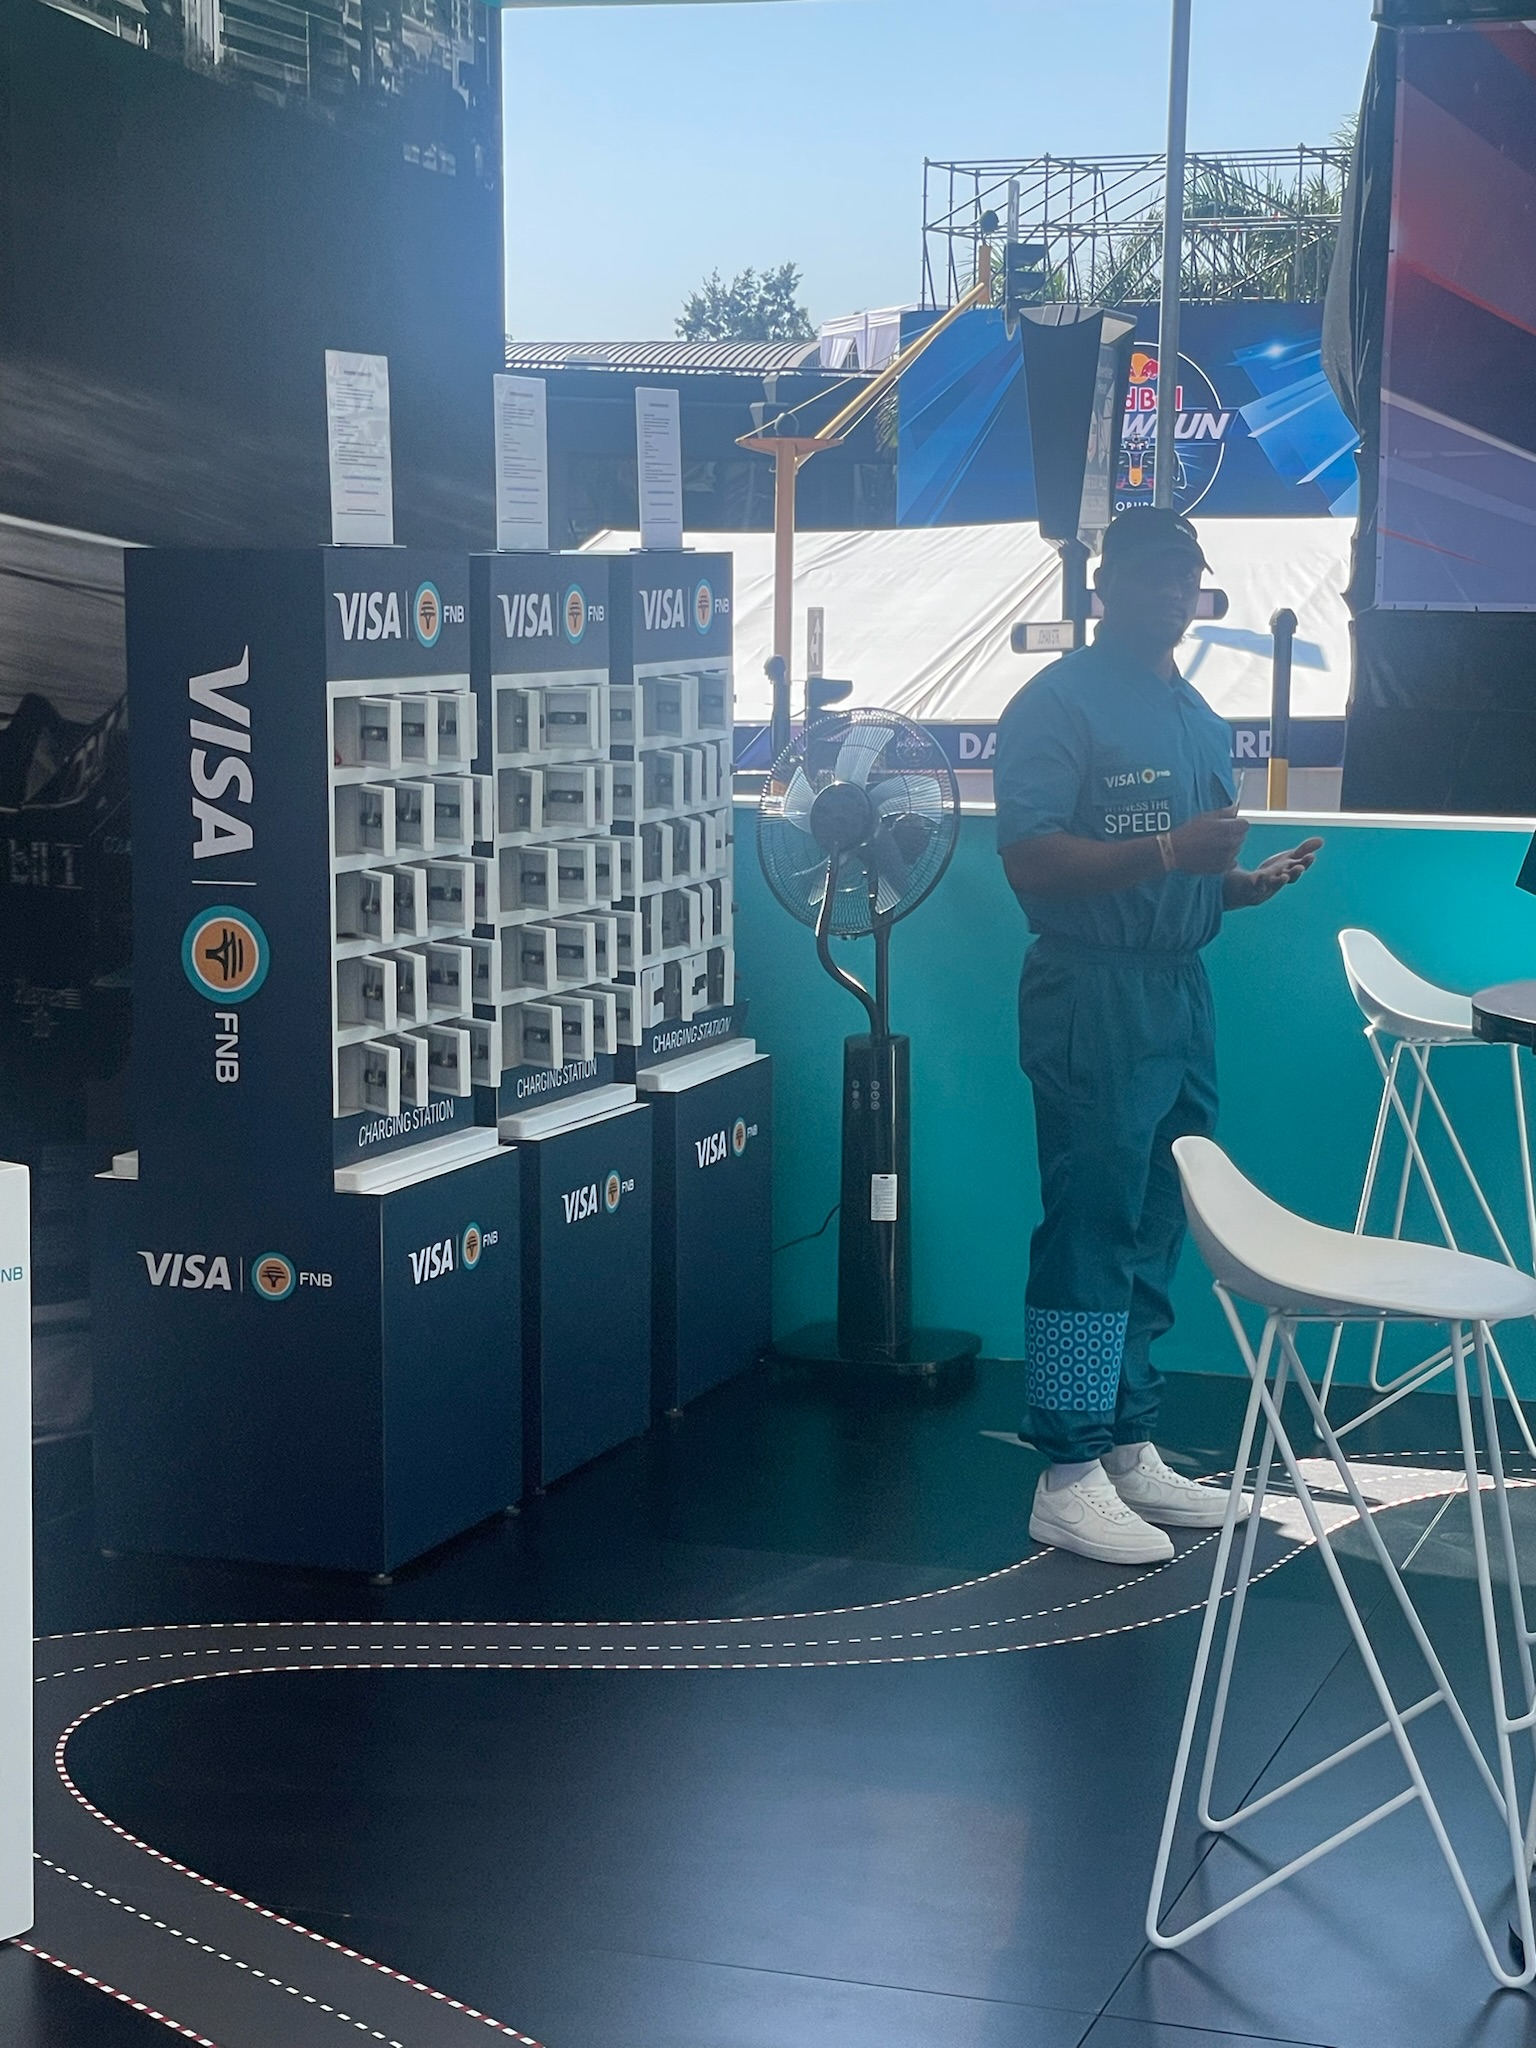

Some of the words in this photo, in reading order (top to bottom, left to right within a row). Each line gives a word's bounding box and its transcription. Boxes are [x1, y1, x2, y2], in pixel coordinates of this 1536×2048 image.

[333, 591, 402, 641] VISA
[443, 605, 465, 623] FNB
[497, 593, 553, 638] VISA
[587, 605, 605, 622] FNB
[639, 588, 685, 630] VISA
[714, 598, 730, 614] FNB
[188, 644, 254, 860] VISA
[1229, 730, 1272, 758] RD
[1103, 772, 1136, 788] VISA
[1104, 811, 1171, 834] SPEED
[1150, 799, 1170, 811] THE
[214, 1012, 239, 1083] FNB
[652, 1025, 698, 1054] CHARGING
[697, 1016, 732, 1041] STATION
[517, 1069, 562, 1099] CHARGING
[562, 1056, 597, 1085] STATION
[358, 1111, 411, 1147] CHARGING
[412, 1098, 455, 1130] STATION
[694, 1130, 727, 1169] VISA
[561, 1183, 598, 1224] VISA
[621, 1178, 635, 1194] FNB
[136, 1250, 233, 1291] VISA
[299, 1271, 333, 1288] FNB
[407, 1238, 454, 1285] VISA
[482, 1230, 499, 1248] FNB
